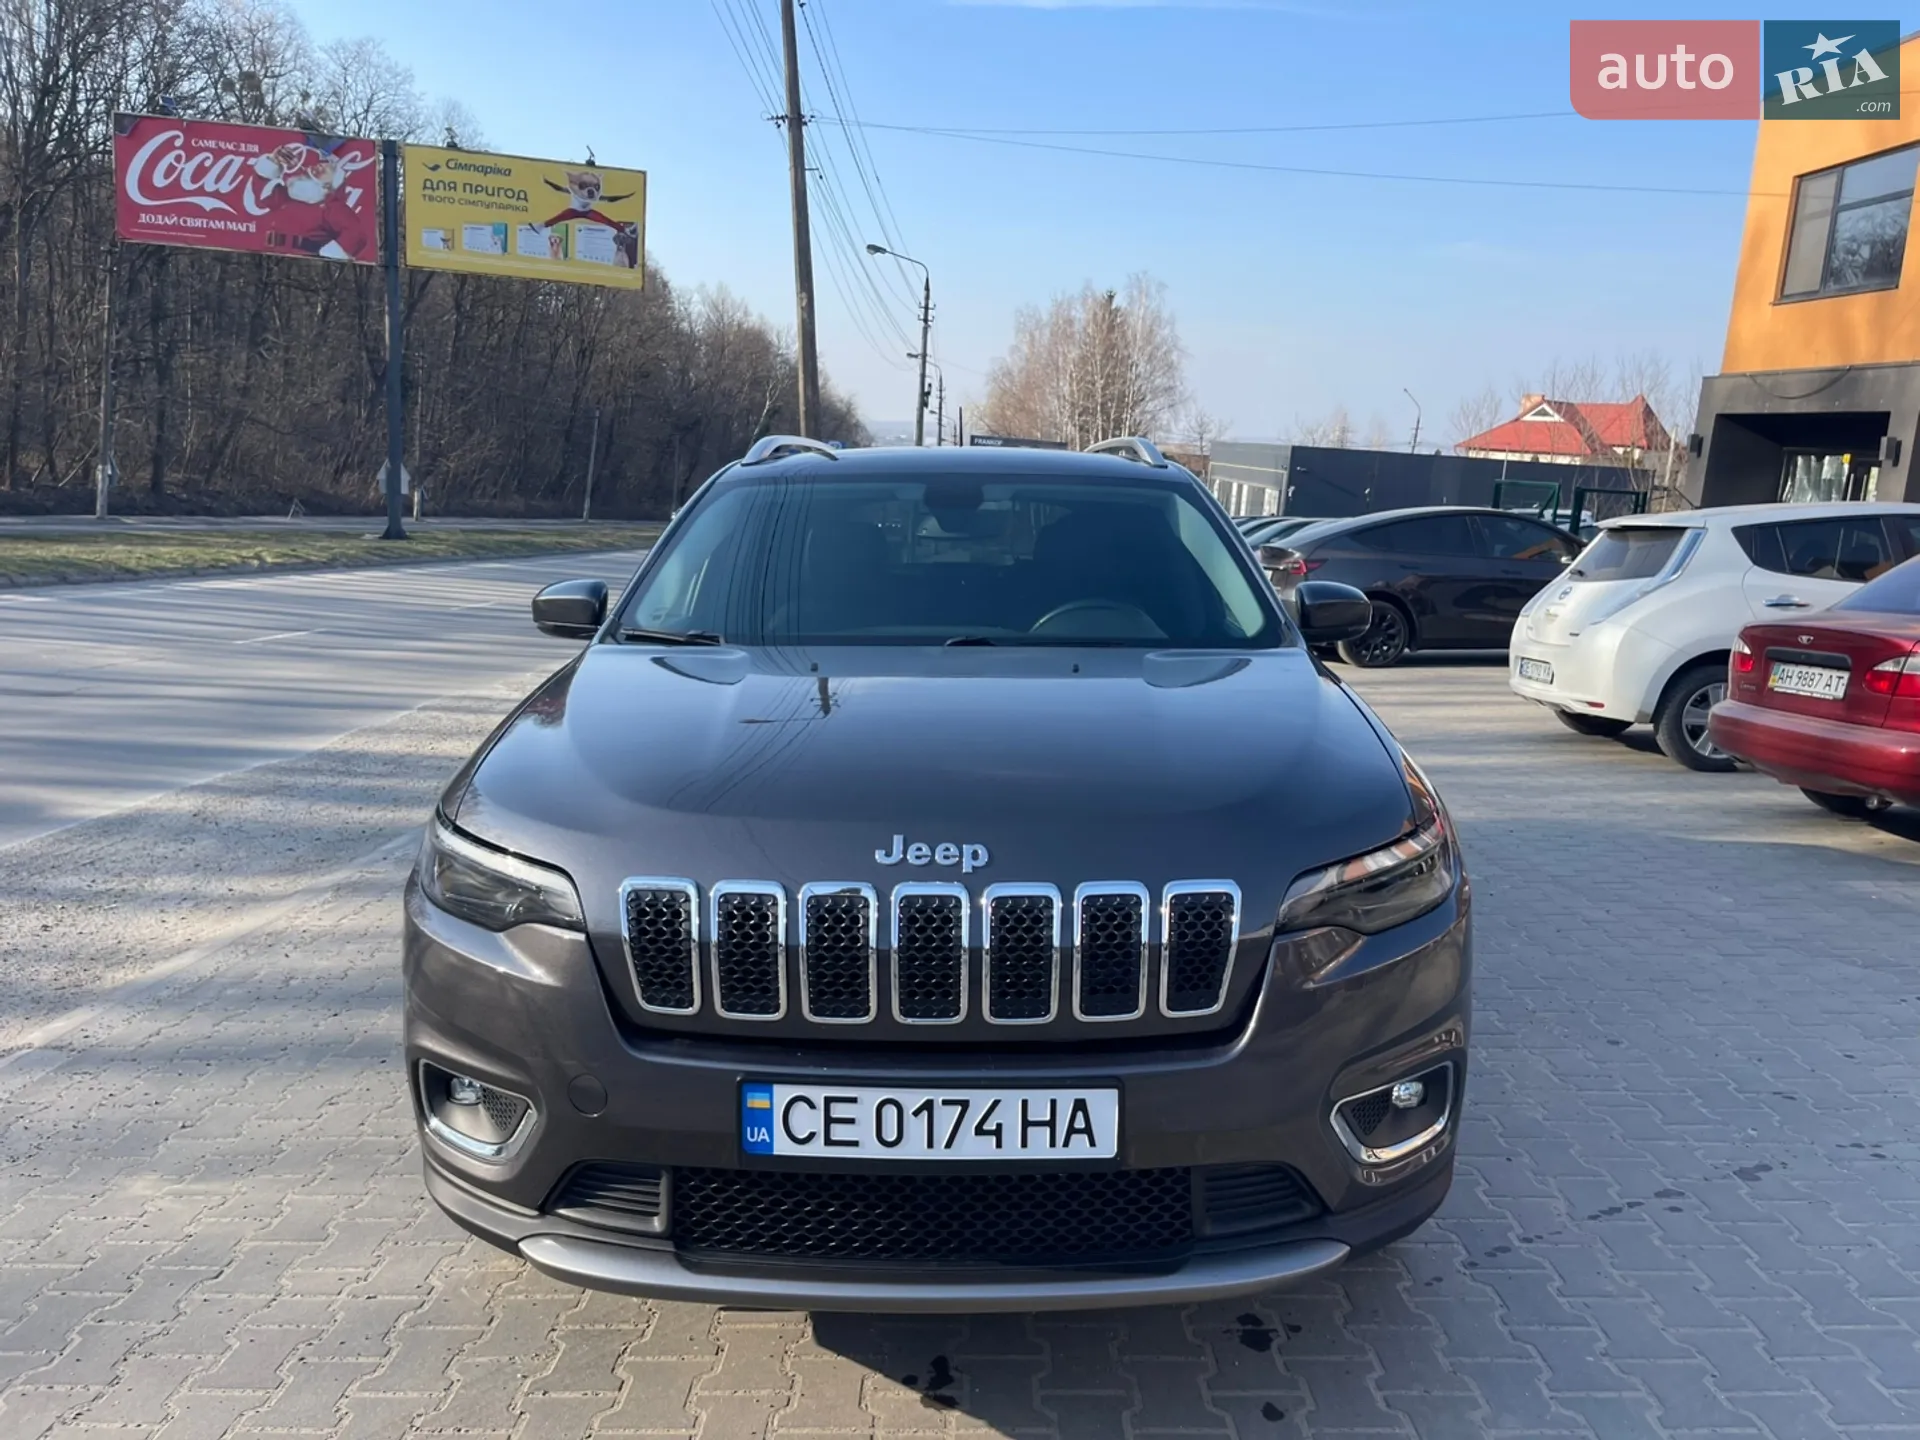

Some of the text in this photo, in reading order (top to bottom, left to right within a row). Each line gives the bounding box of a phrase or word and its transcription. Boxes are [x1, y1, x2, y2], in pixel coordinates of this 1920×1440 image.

[191, 138, 219, 149] САМЕ
[219, 140, 238, 151] ЧАС
[445, 158, 512, 177] Сімпаріка
[138, 212, 256, 234] ДОДАЙ СВЯТАМ МАГІЇ
[1795, 670, 1823, 688] 9887
[874, 833, 990, 873] Jeep
[781, 1094, 1098, 1150] CE 0174 HA
[746, 1127, 771, 1143] UA
